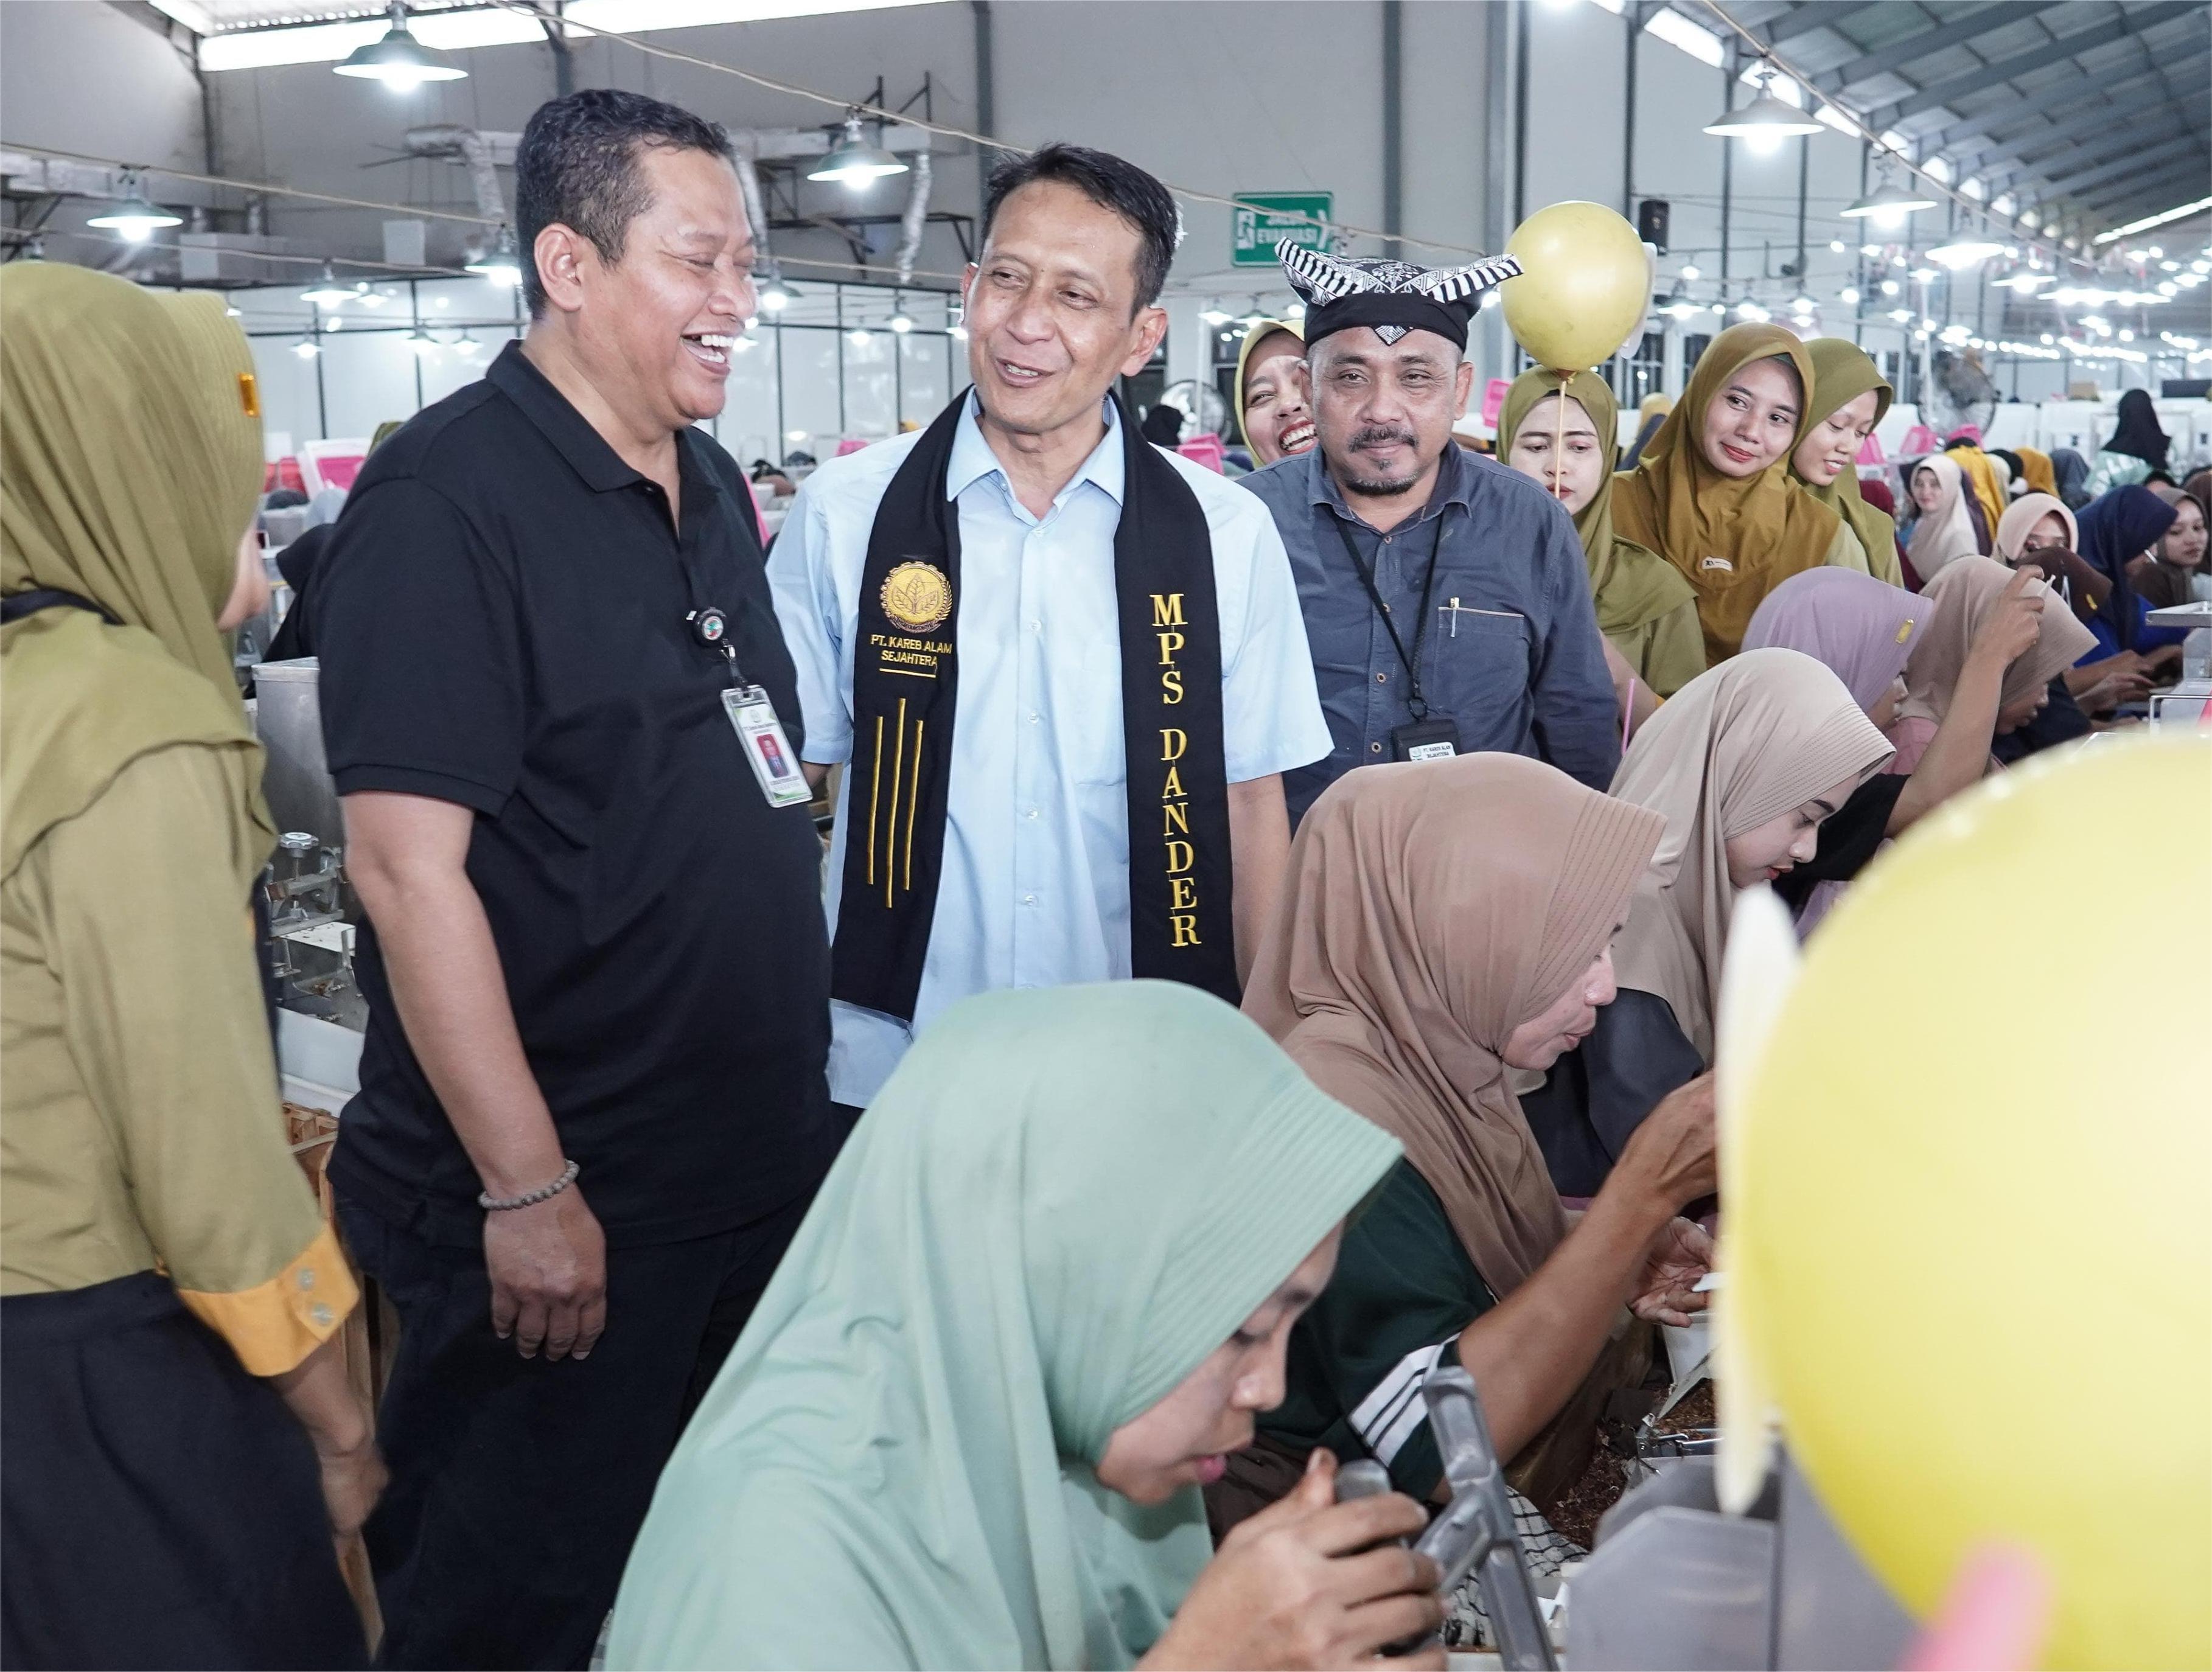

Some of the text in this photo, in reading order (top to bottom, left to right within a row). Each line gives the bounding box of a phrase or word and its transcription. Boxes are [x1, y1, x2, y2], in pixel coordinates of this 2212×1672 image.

[888, 636, 922, 650] KAREB
[923, 641, 952, 654] ALAM
[881, 650, 938, 666] SEJAHTERA
[1149, 593, 1202, 947] MPS DANDER
